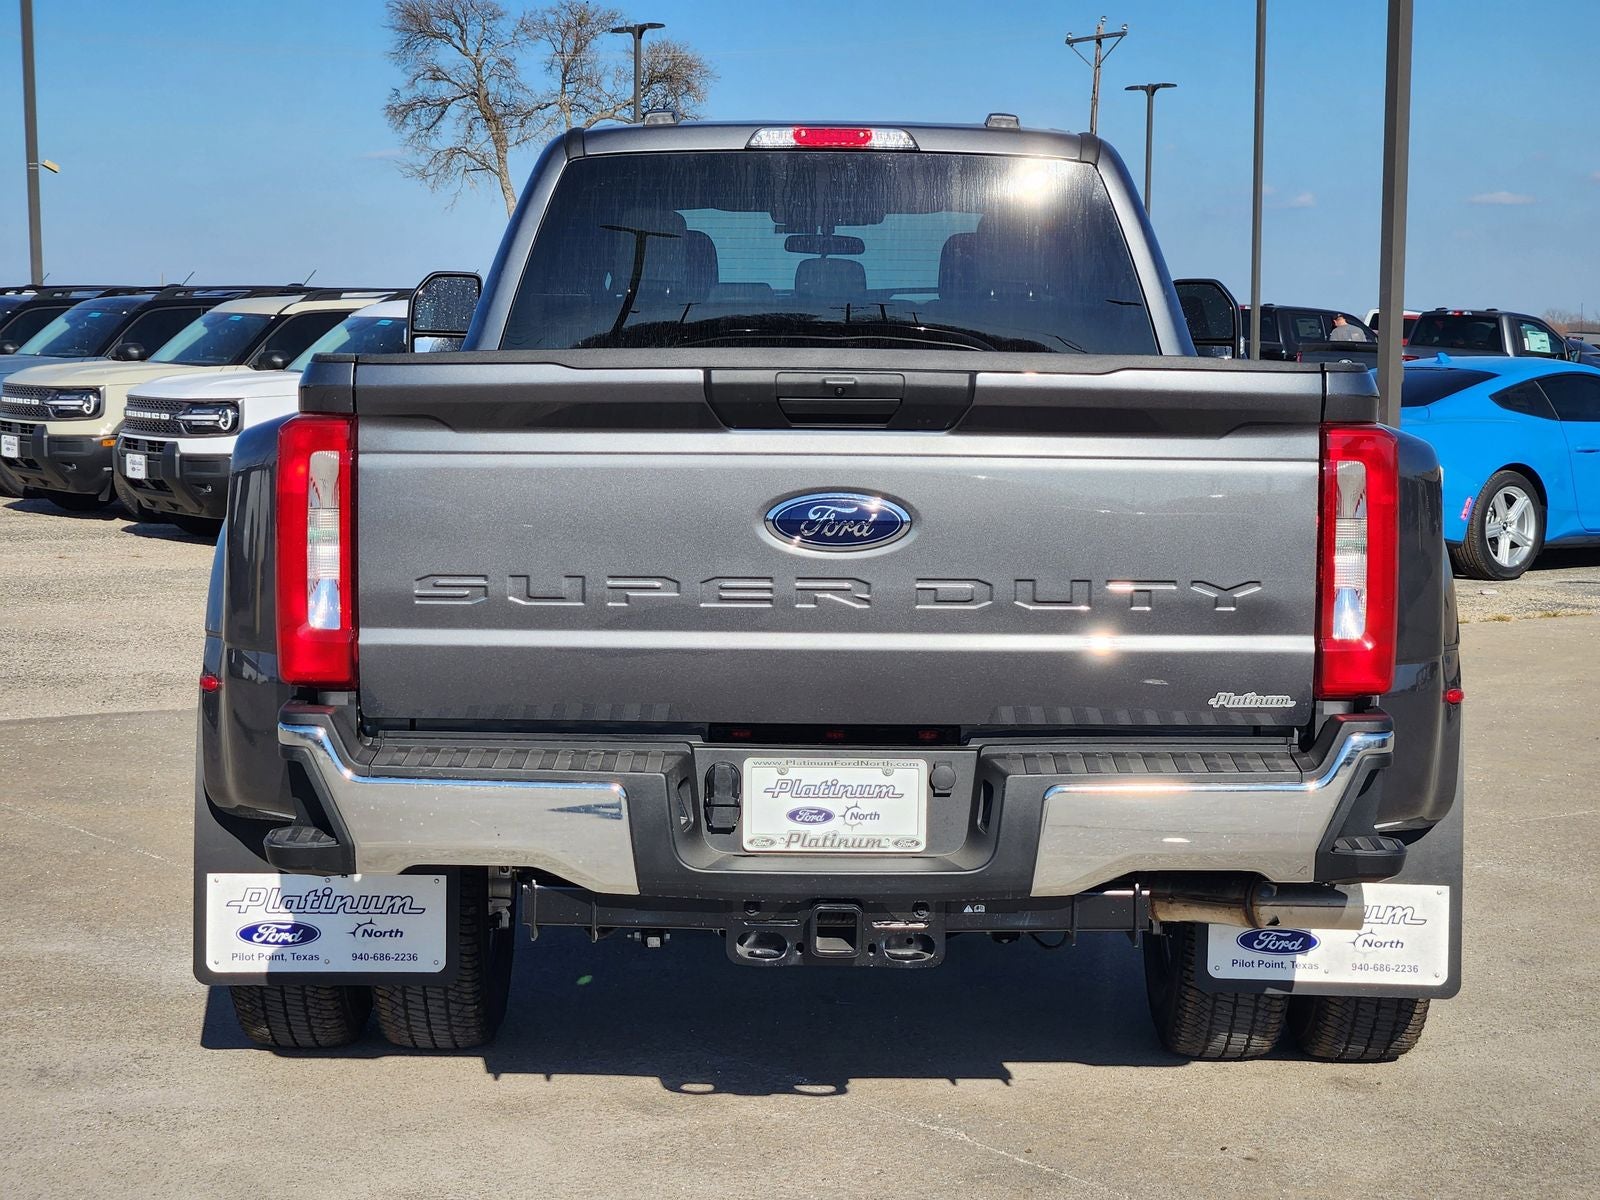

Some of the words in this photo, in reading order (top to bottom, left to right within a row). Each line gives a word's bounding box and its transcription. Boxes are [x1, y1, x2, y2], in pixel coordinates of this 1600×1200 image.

[800, 505, 877, 537] Ford
[414, 574, 871, 608] SUPER
[915, 578, 1262, 611] DUTY
[1208, 692, 1296, 708] Platinum
[752, 759, 919, 768] www.PlatinumFordNorth.com
[763, 778, 904, 799] Platinum
[796, 809, 825, 822] Ford
[850, 811, 880, 821] North
[785, 830, 888, 849] Platinum
[226, 887, 426, 915] Platinum
[252, 923, 303, 943] Ford
[361, 928, 404, 939] North
[1253, 930, 1304, 950] Ford
[1361, 938, 1404, 949] North
[231, 952, 255, 962] Pilot
[258, 952, 288, 963] Point,
[290, 952, 320, 962] Texas
[351, 952, 418, 962] 940-686-2236
[1231, 959, 1255, 969] Pilot
[1257, 959, 1287, 971] Point,
[1290, 960, 1319, 970] Texas
[1351, 963, 1419, 974] 940-686-2236
